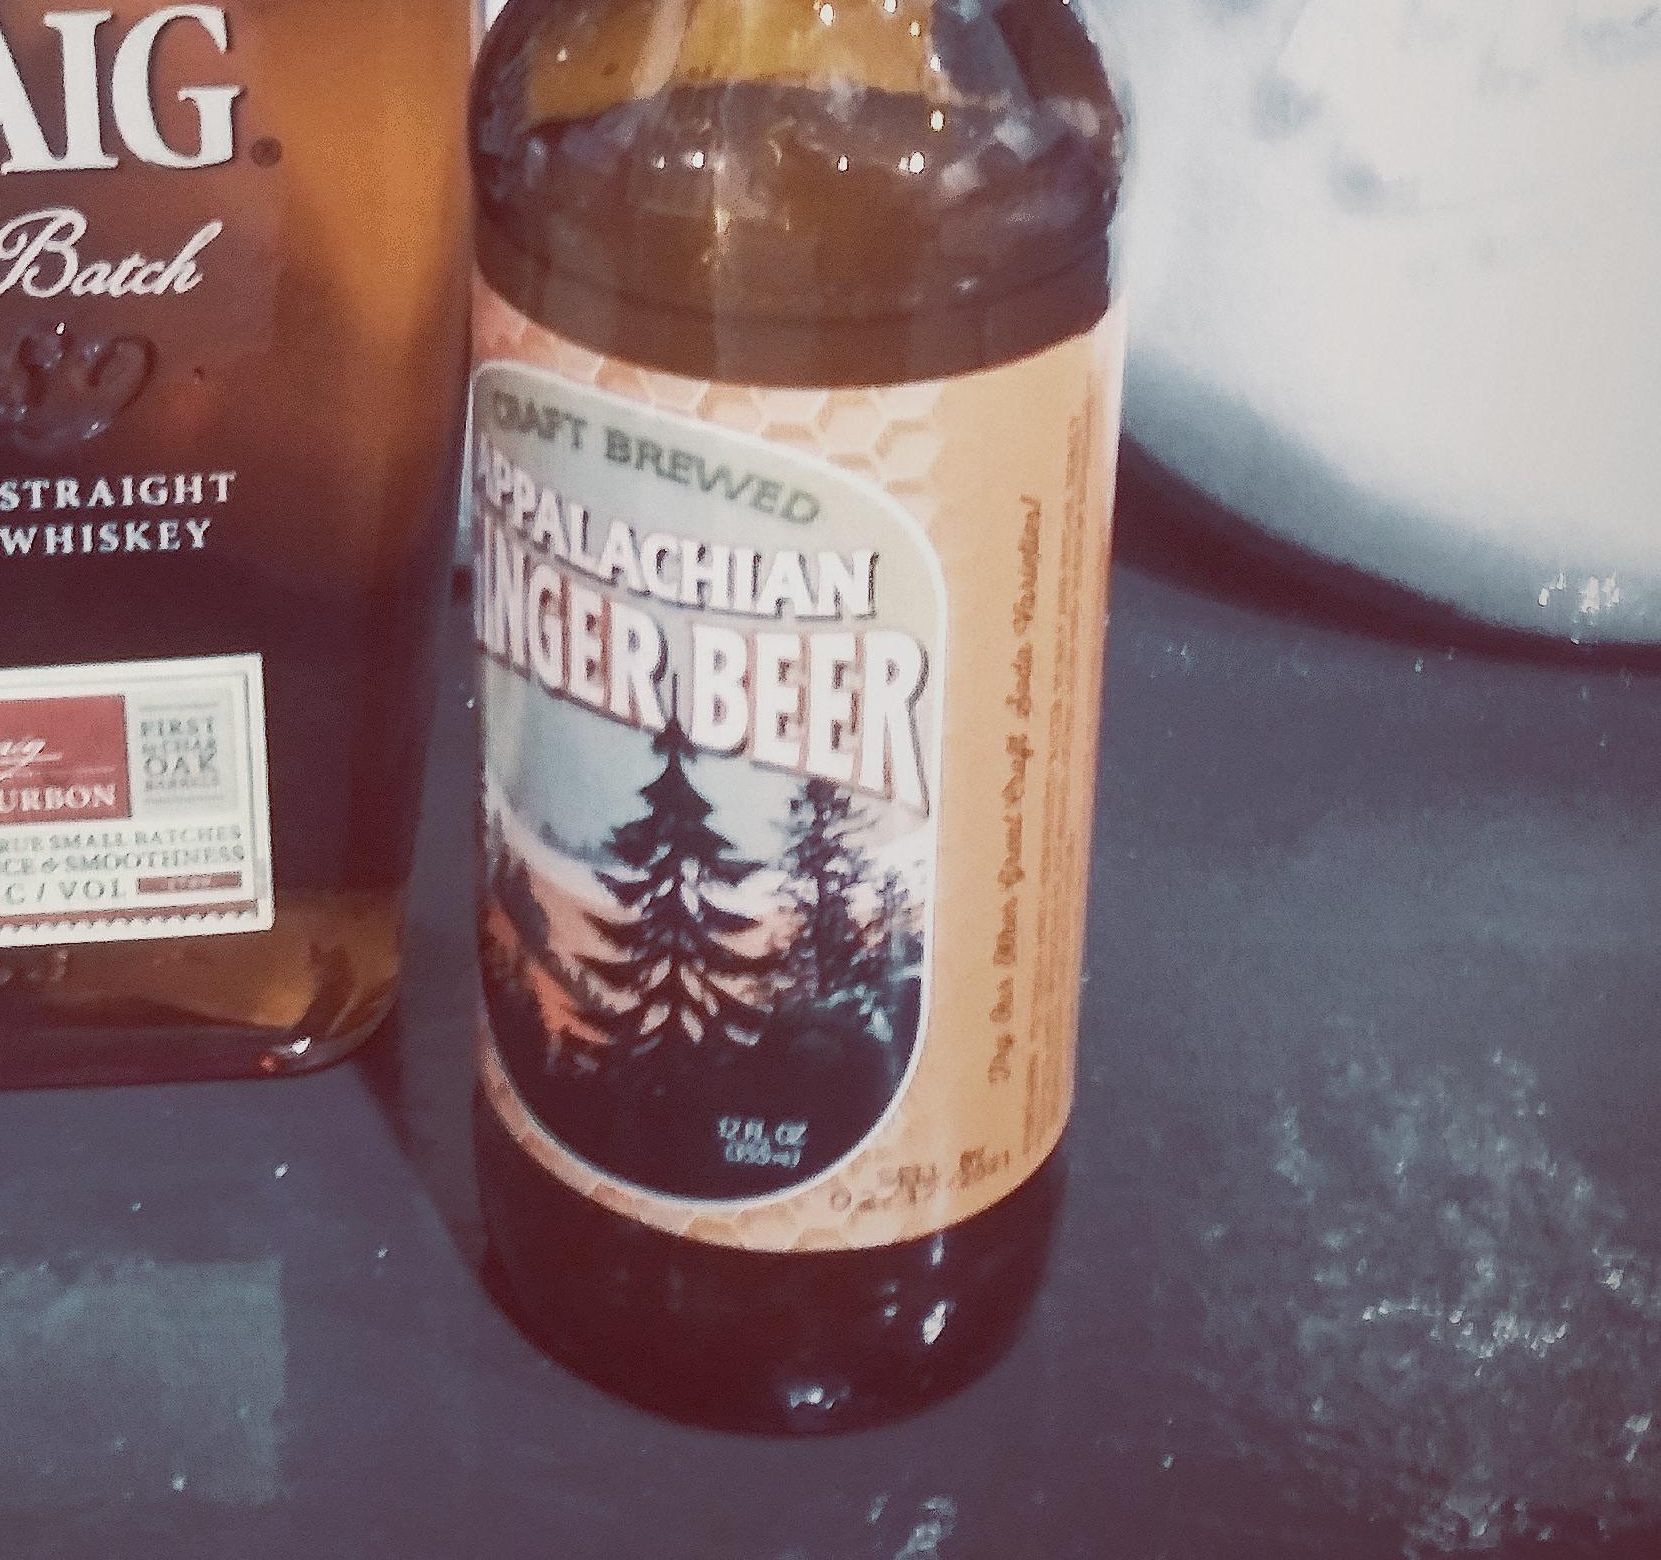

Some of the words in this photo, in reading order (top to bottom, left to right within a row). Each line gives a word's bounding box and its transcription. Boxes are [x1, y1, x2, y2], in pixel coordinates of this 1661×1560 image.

[604, 426, 820, 526] BREWED
[689, 623, 929, 816] BEER
[143, 753, 220, 777] OAK
[49, 831, 124, 851] SMALL
[134, 824, 242, 846] BATCHES
[65, 844, 245, 873] SMOOTHNESS
